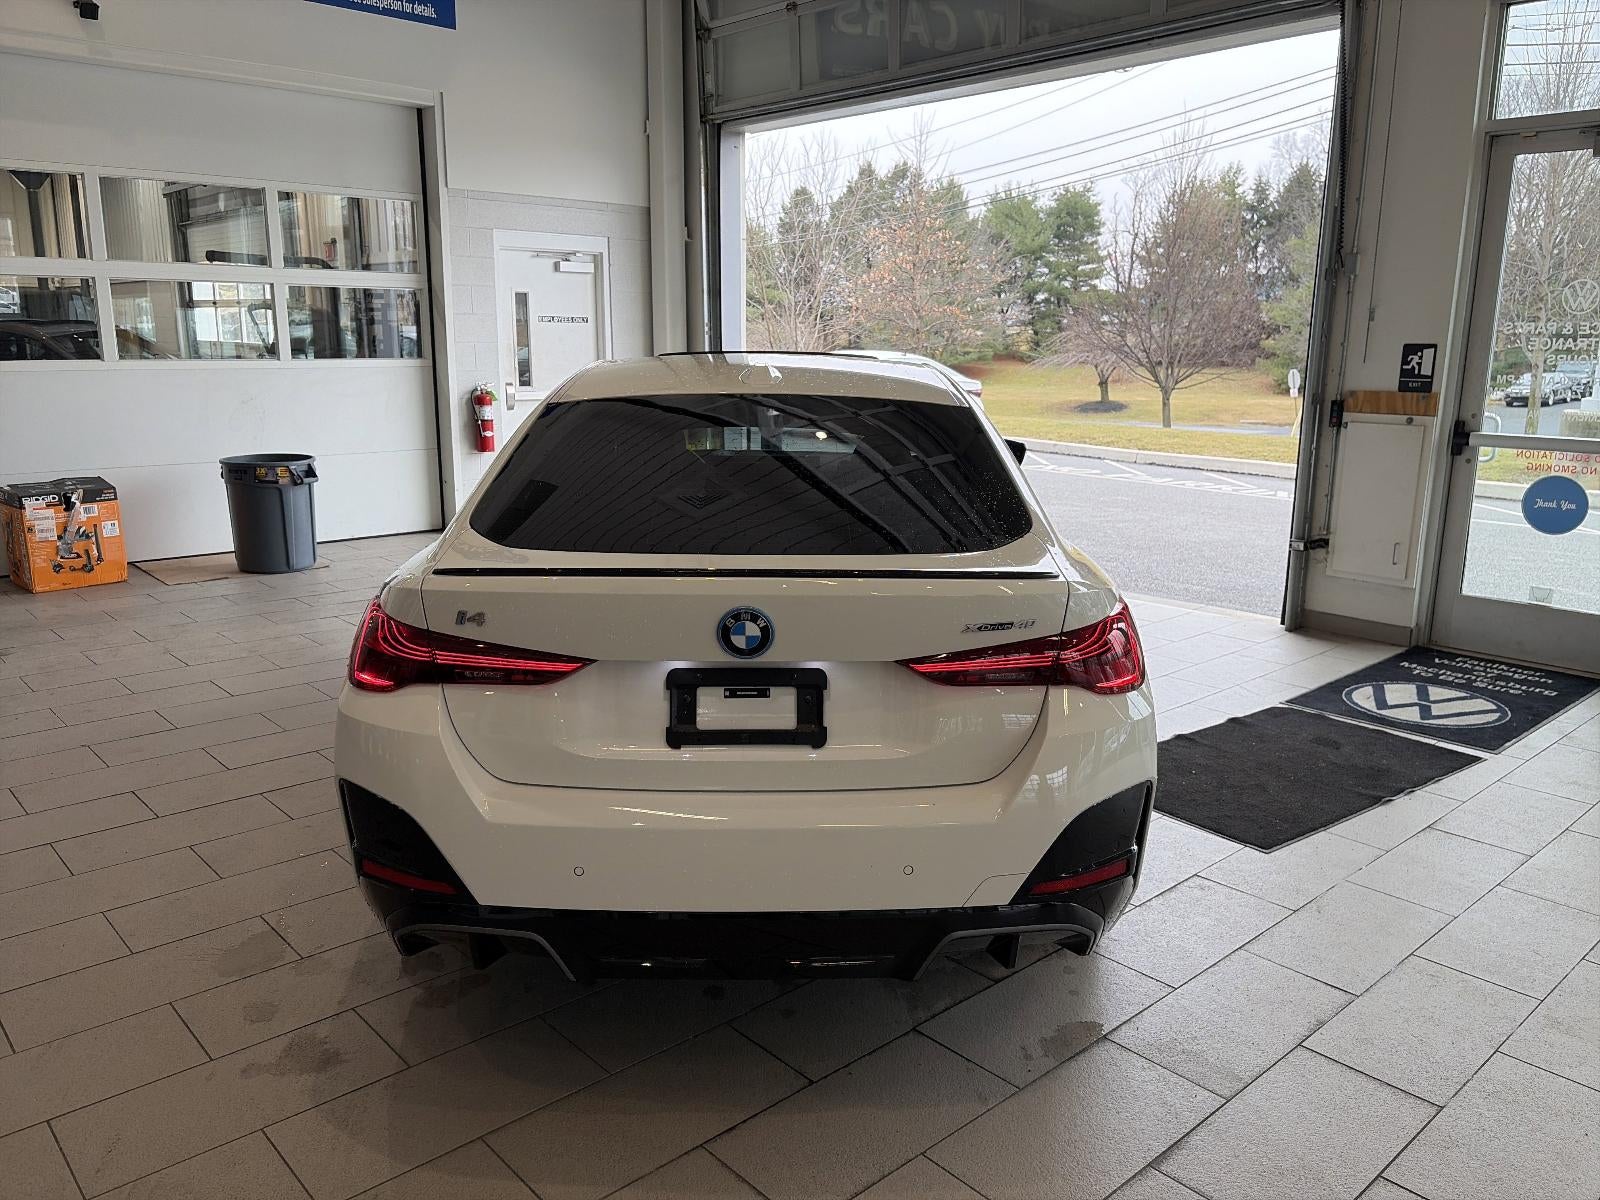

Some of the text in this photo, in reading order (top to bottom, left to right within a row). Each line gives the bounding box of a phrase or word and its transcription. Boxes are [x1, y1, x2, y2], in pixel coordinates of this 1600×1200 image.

[403, 3, 413, 13] for
[413, 6, 437, 18] details.
[22, 495, 59, 505] RIDGID
[1533, 498, 1577, 511] Thank You
[1455, 657, 1545, 676] Faulkner
[1413, 669, 1434, 678] To
[1438, 675, 1467, 684] Be
